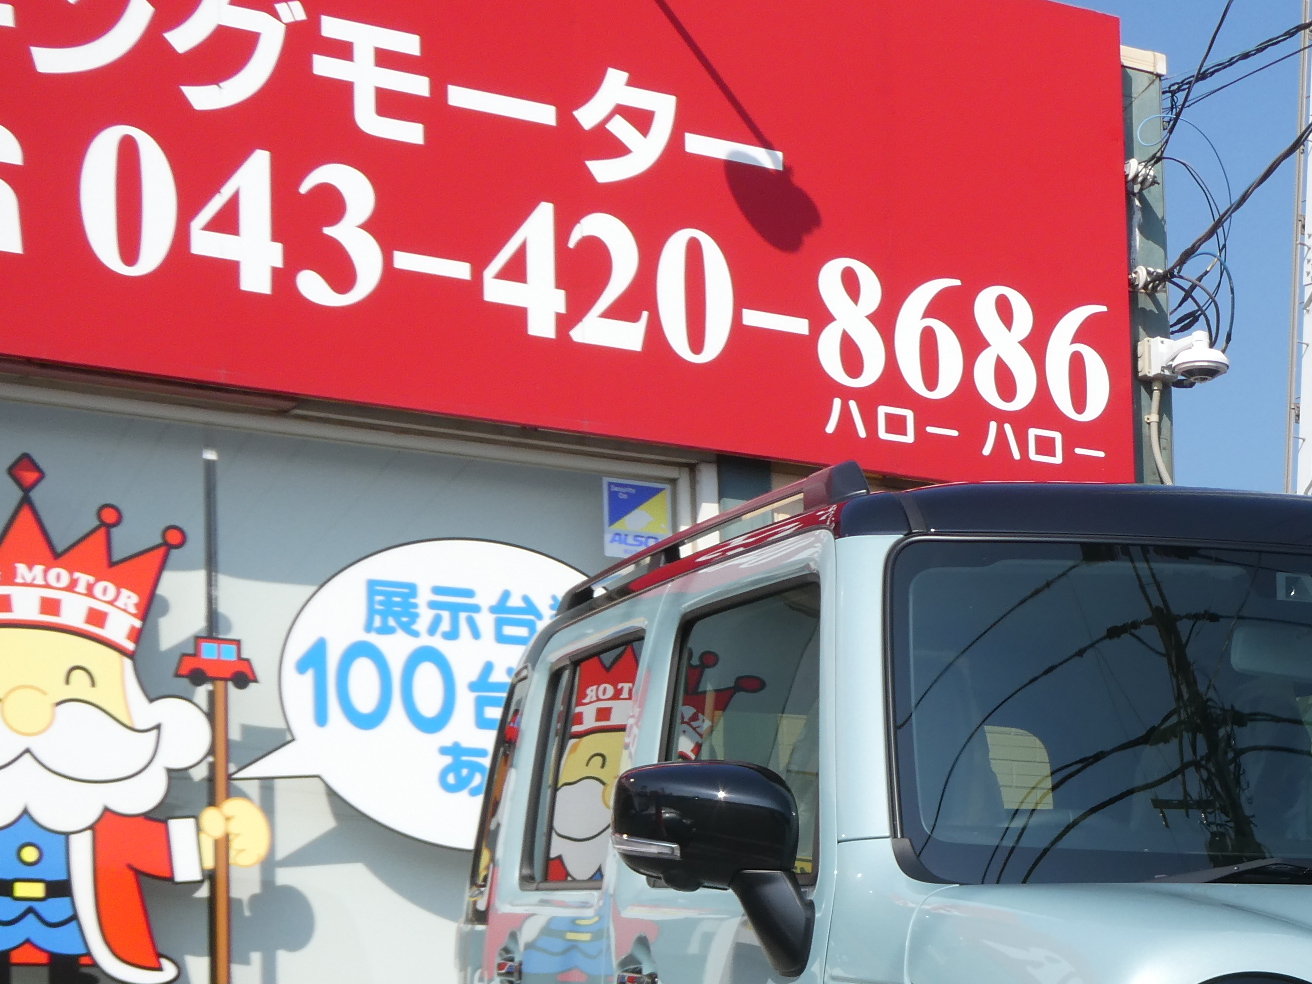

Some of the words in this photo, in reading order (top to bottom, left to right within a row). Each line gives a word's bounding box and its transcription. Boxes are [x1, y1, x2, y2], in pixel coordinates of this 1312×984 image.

[0, 0, 784, 183] ングモーター
[825, 397, 960, 444] ハロー
[982, 420, 1106, 465] ハロー
[609, 532, 660, 548] ALSO
[14, 562, 140, 614] MOTOR
[364, 578, 560, 646] 展示台
